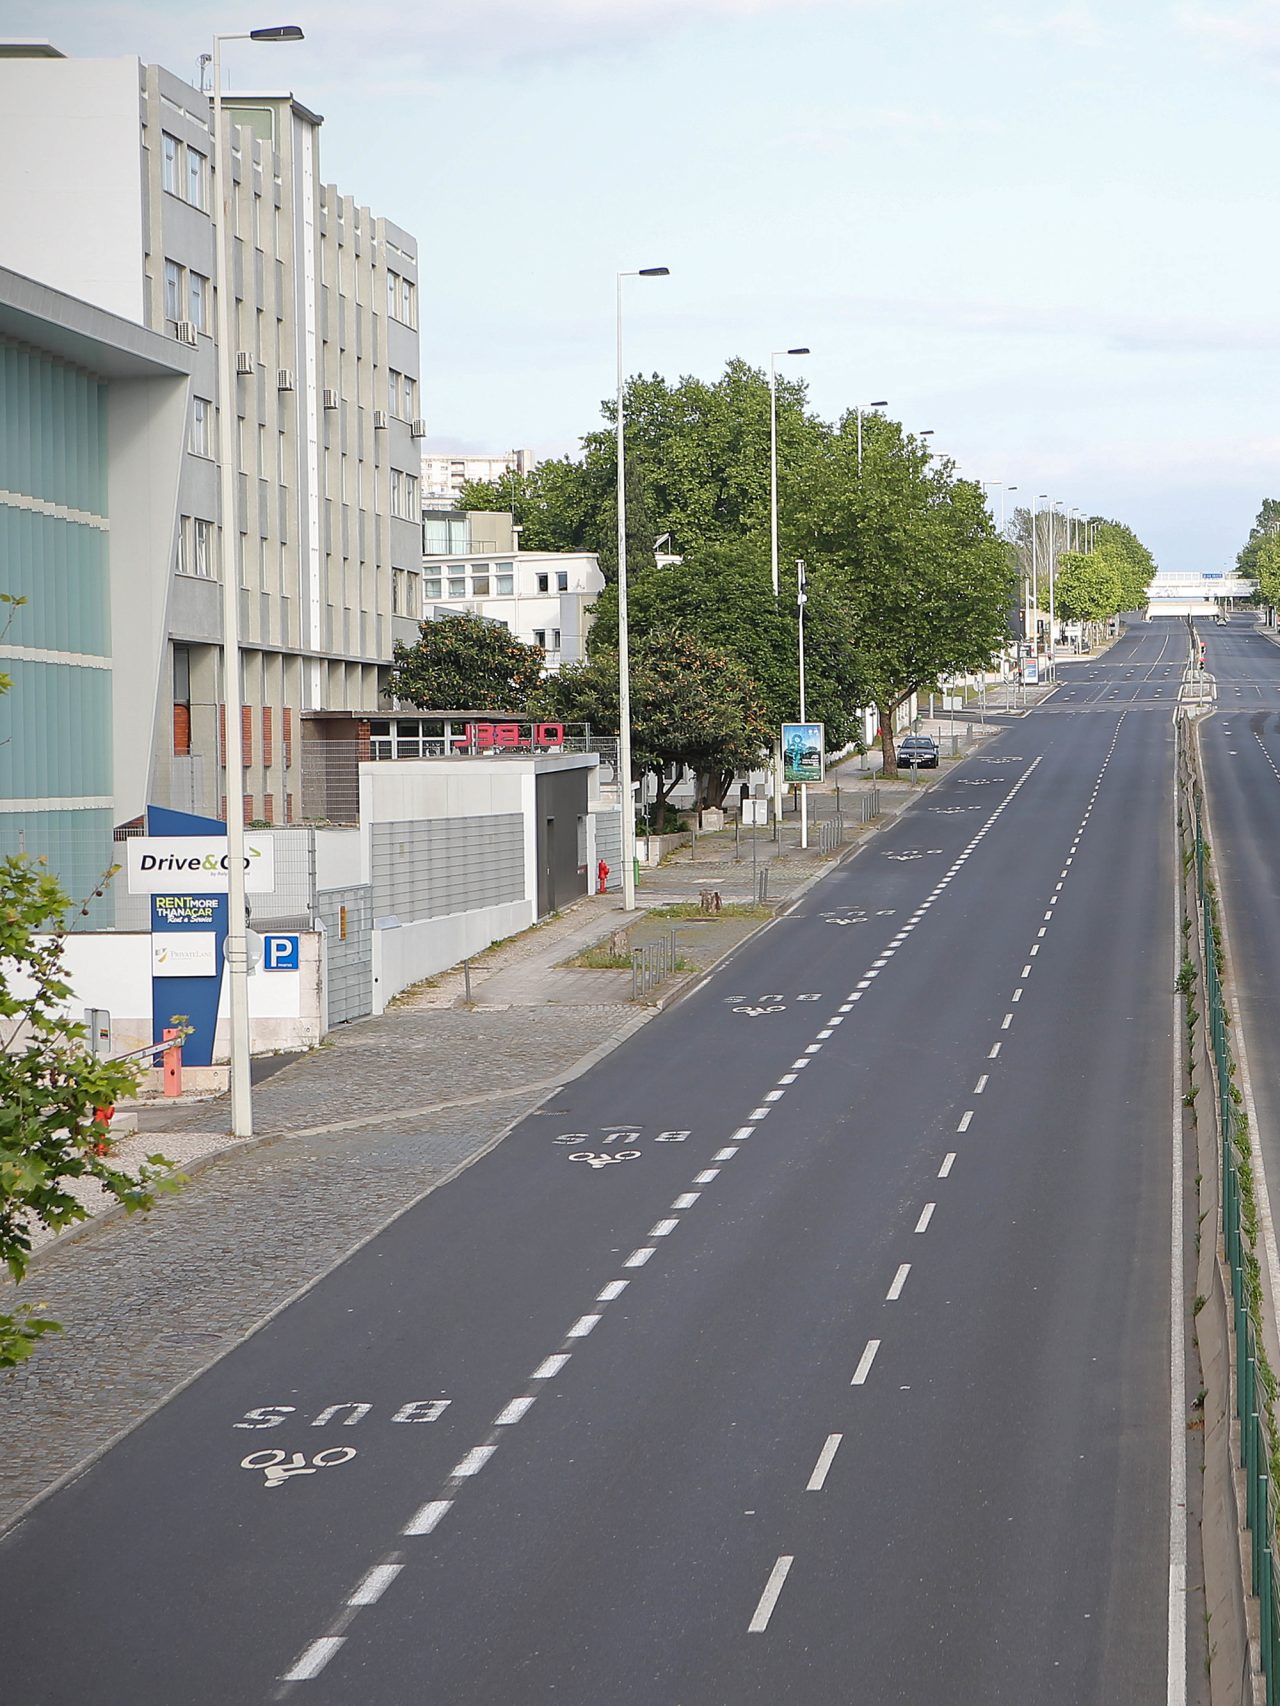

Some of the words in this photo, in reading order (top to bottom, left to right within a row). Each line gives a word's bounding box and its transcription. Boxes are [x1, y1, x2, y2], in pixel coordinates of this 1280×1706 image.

[271, 939, 292, 968] P
[551, 1130, 692, 1145] BUS
[232, 1399, 452, 1429] BUS
